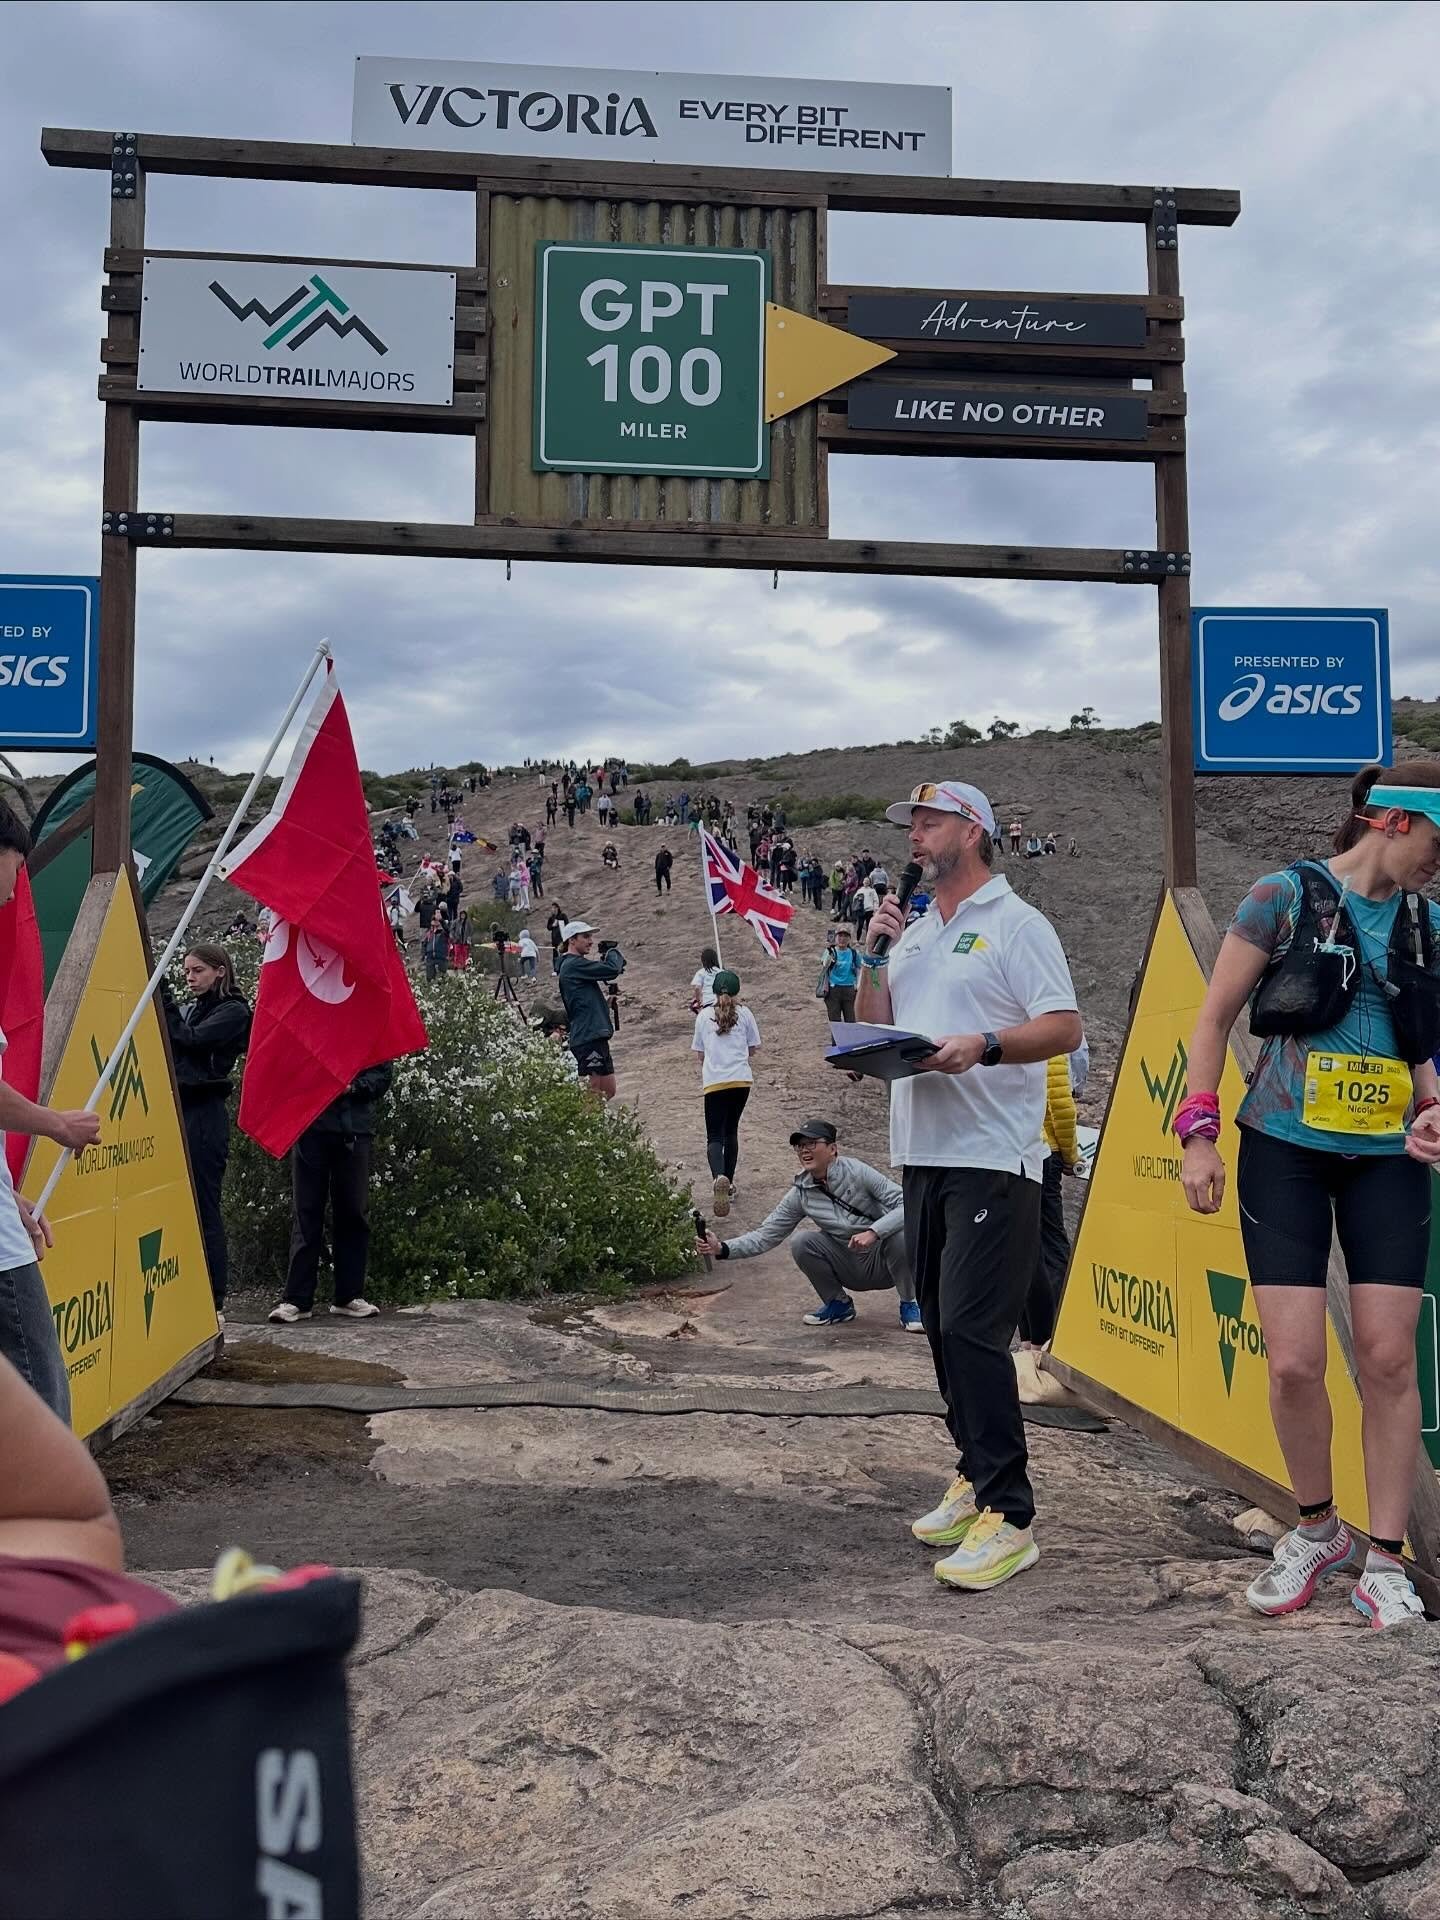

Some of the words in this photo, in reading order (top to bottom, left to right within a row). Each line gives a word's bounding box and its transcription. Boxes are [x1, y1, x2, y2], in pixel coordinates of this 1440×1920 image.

[679, 99, 789, 124] EVERY
[797, 105, 848, 127] BIT
[745, 123, 926, 152] DIFFERENT
[579, 278, 729, 336] GPT
[920, 299, 1086, 339] Adventure
[179, 361, 415, 392] WORLDTRAILMAJORS
[586, 344, 722, 407] 100
[894, 399, 955, 420] LIKE
[962, 402, 1004, 423] NO
[1012, 404, 1105, 427] OTHER
[620, 422, 687, 439] MILER
[32, 626, 52, 638] BY
[1234, 656, 1320, 668] PRESENTED
[1326, 656, 1345, 668] BY
[1348, 1062, 1383, 1073] MIER
[1334, 1080, 1391, 1105] 1025
[1347, 1105, 1375, 1115] Nicole
[50, 1280, 111, 1353] TORiA
[1099, 1318, 1118, 1337] EVERY
[1118, 1326, 1129, 1342] BIT
[1129, 1331, 1165, 1359] DIFFERENT
[65, 1348, 102, 1381] IFFERENT
